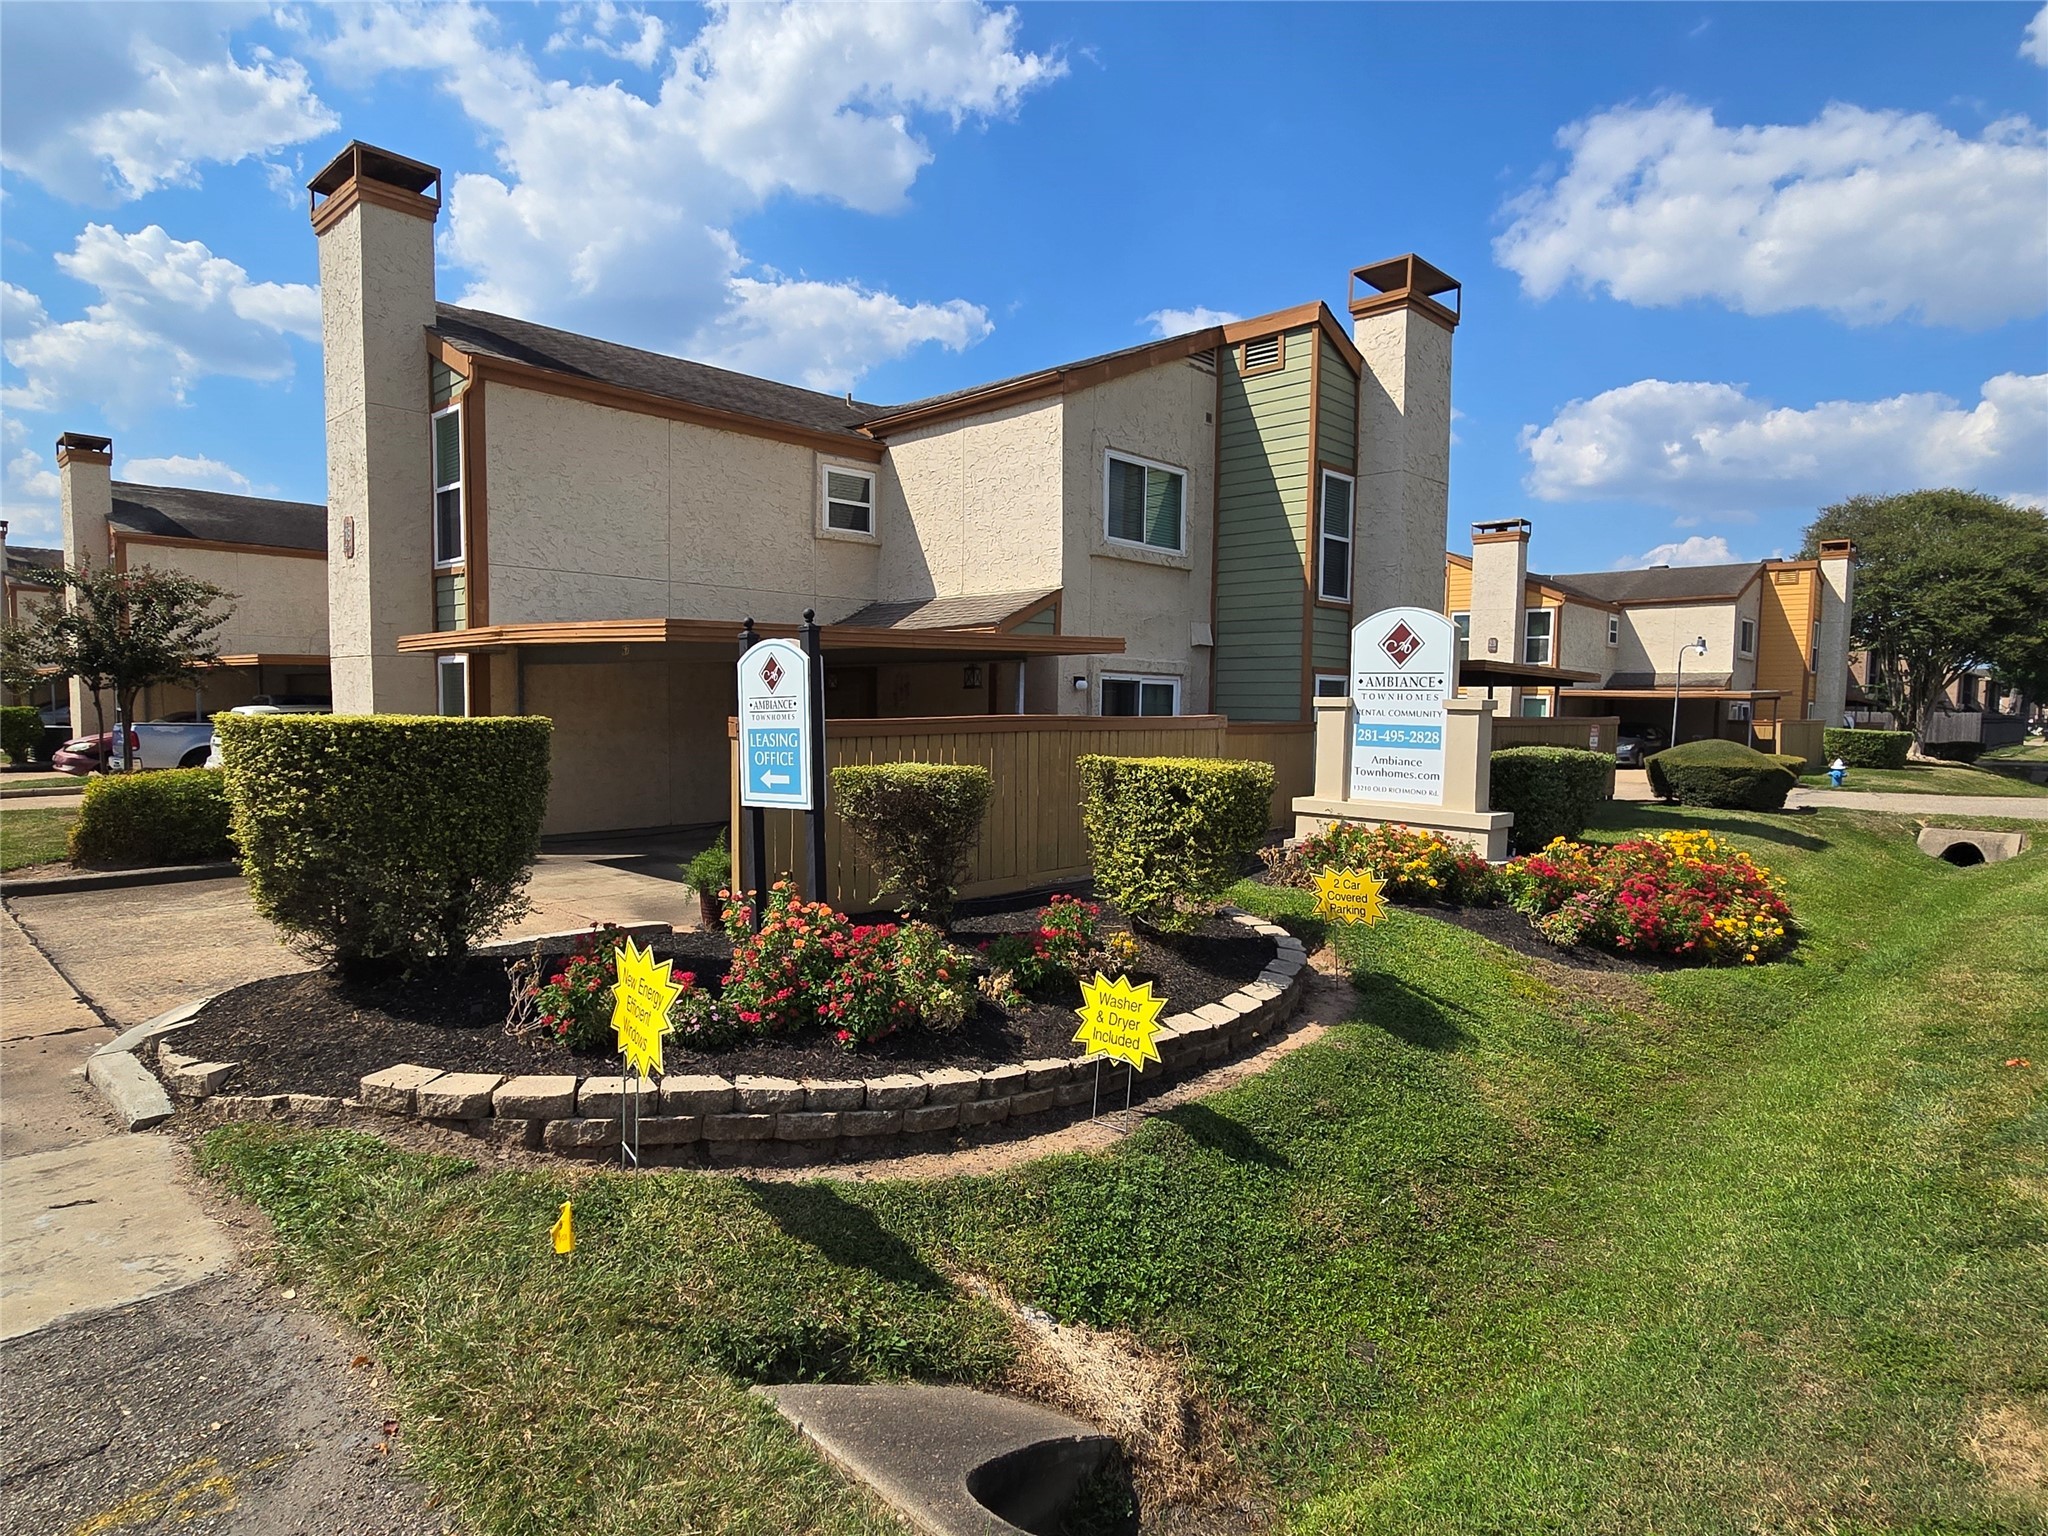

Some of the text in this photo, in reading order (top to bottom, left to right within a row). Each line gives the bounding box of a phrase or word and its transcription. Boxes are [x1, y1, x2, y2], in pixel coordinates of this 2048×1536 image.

[1365, 676, 1436, 688] AMBIANCE
[753, 700, 793, 710] AMBIANCE
[1388, 710, 1442, 718] COMMUNITY
[750, 733, 798, 748] LEASING
[1358, 729, 1440, 744] 281-495-2828
[755, 752, 794, 766] OFFICE
[1371, 755, 1423, 767] Ambiance
[1354, 767, 1440, 781] Townhomes.com
[1389, 788, 1427, 796] RICHMOND
[1334, 879, 1360, 890] 2 Car
[1327, 891, 1367, 903] Covered
[1330, 904, 1366, 917] Parking
[623, 967, 664, 1010] New Energy
[1100, 992, 1142, 1012] Washer
[626, 996, 651, 1026] Efficient
[1097, 1010, 1140, 1032] & Dryer
[623, 1016, 648, 1051] Windows
[1093, 1027, 1140, 1049] Included
